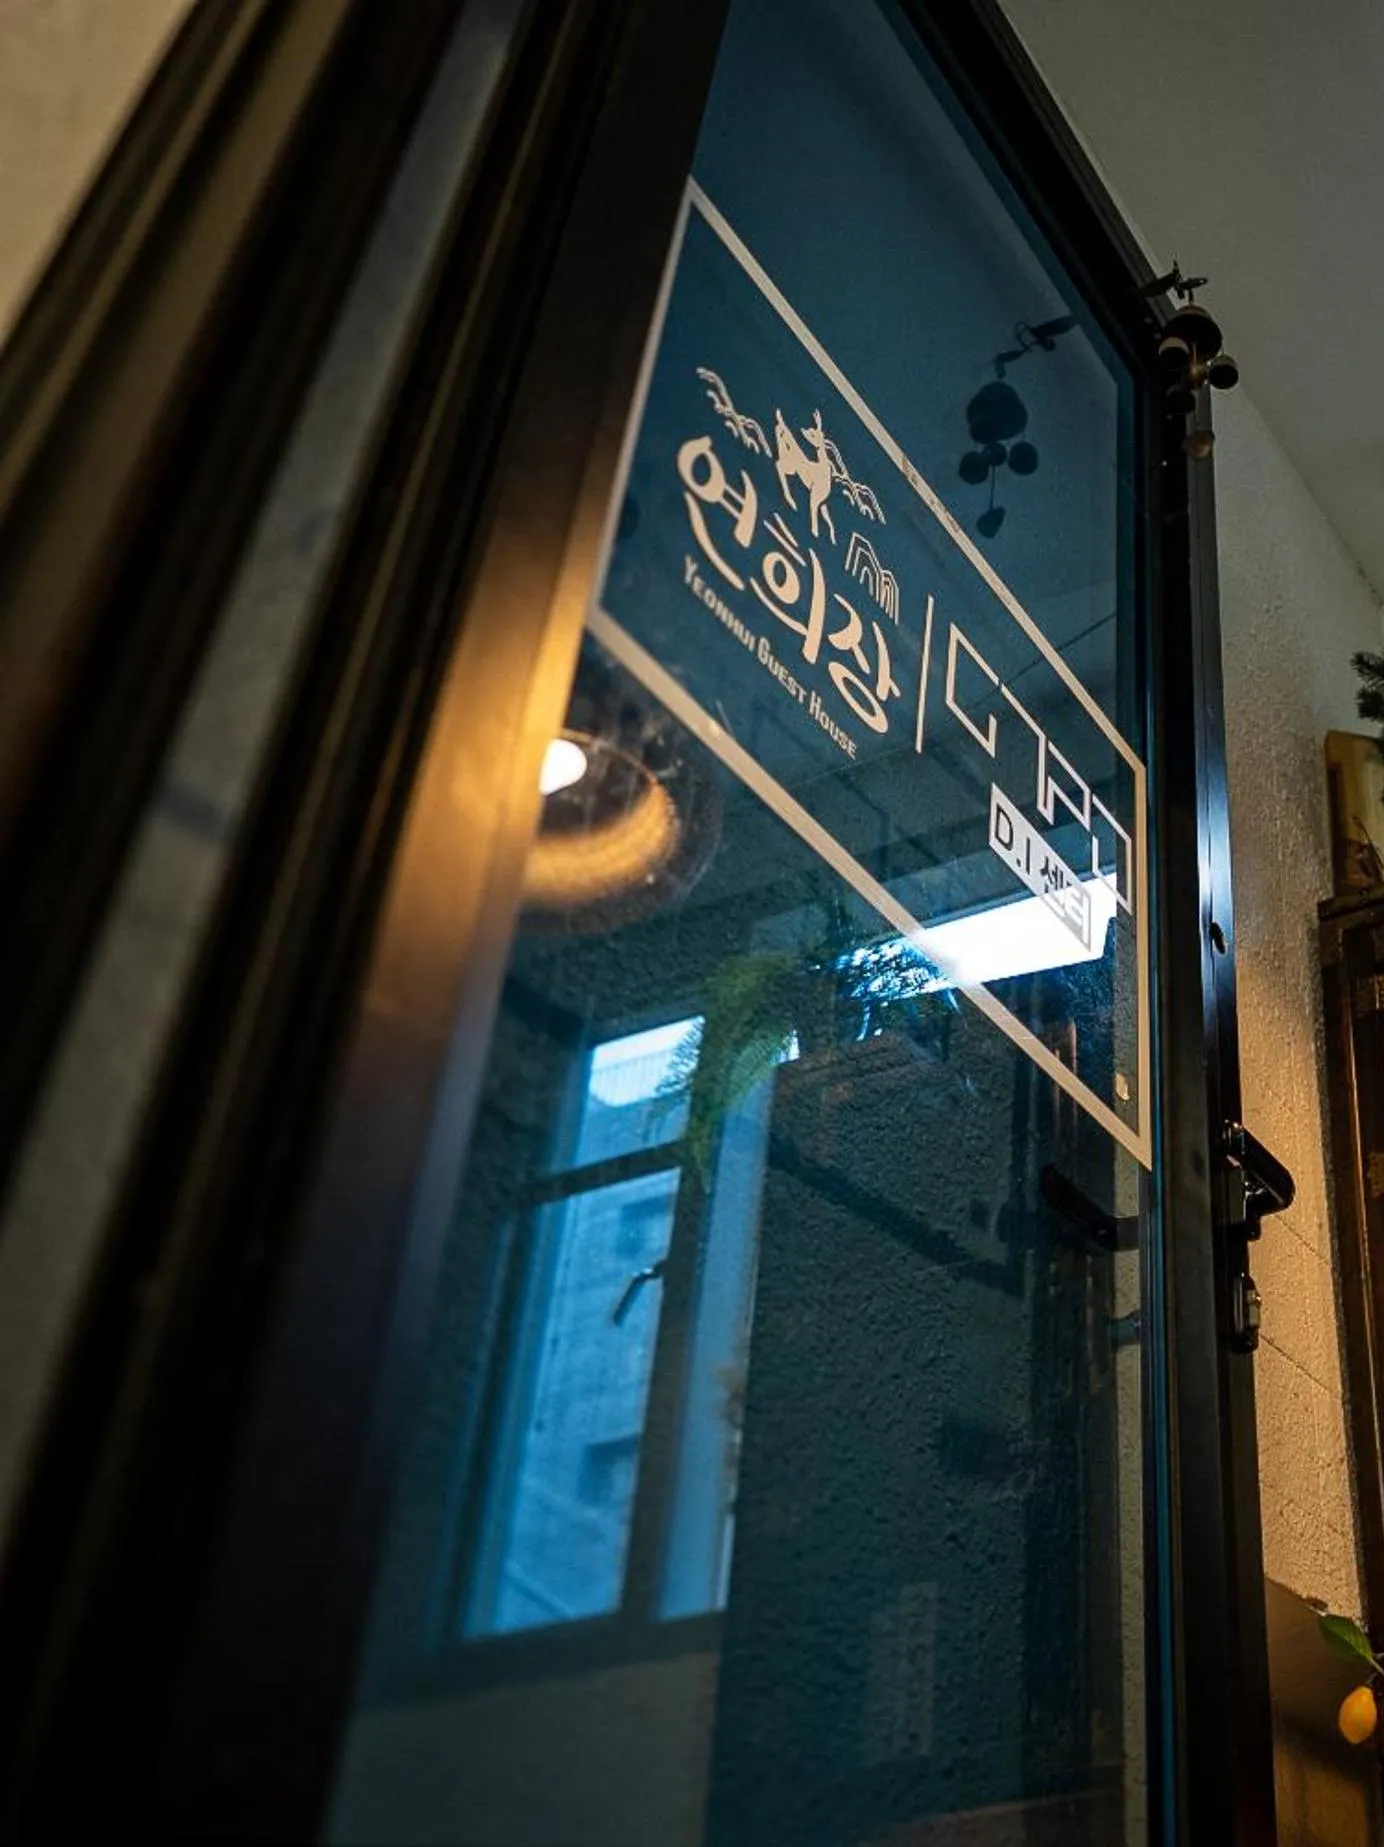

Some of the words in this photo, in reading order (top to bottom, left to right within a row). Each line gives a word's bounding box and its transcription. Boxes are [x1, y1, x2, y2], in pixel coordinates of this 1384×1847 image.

[677, 436, 900, 733] 연희장
[758, 636, 806, 704] GUEST
[809, 690, 858, 760] HOUSE
